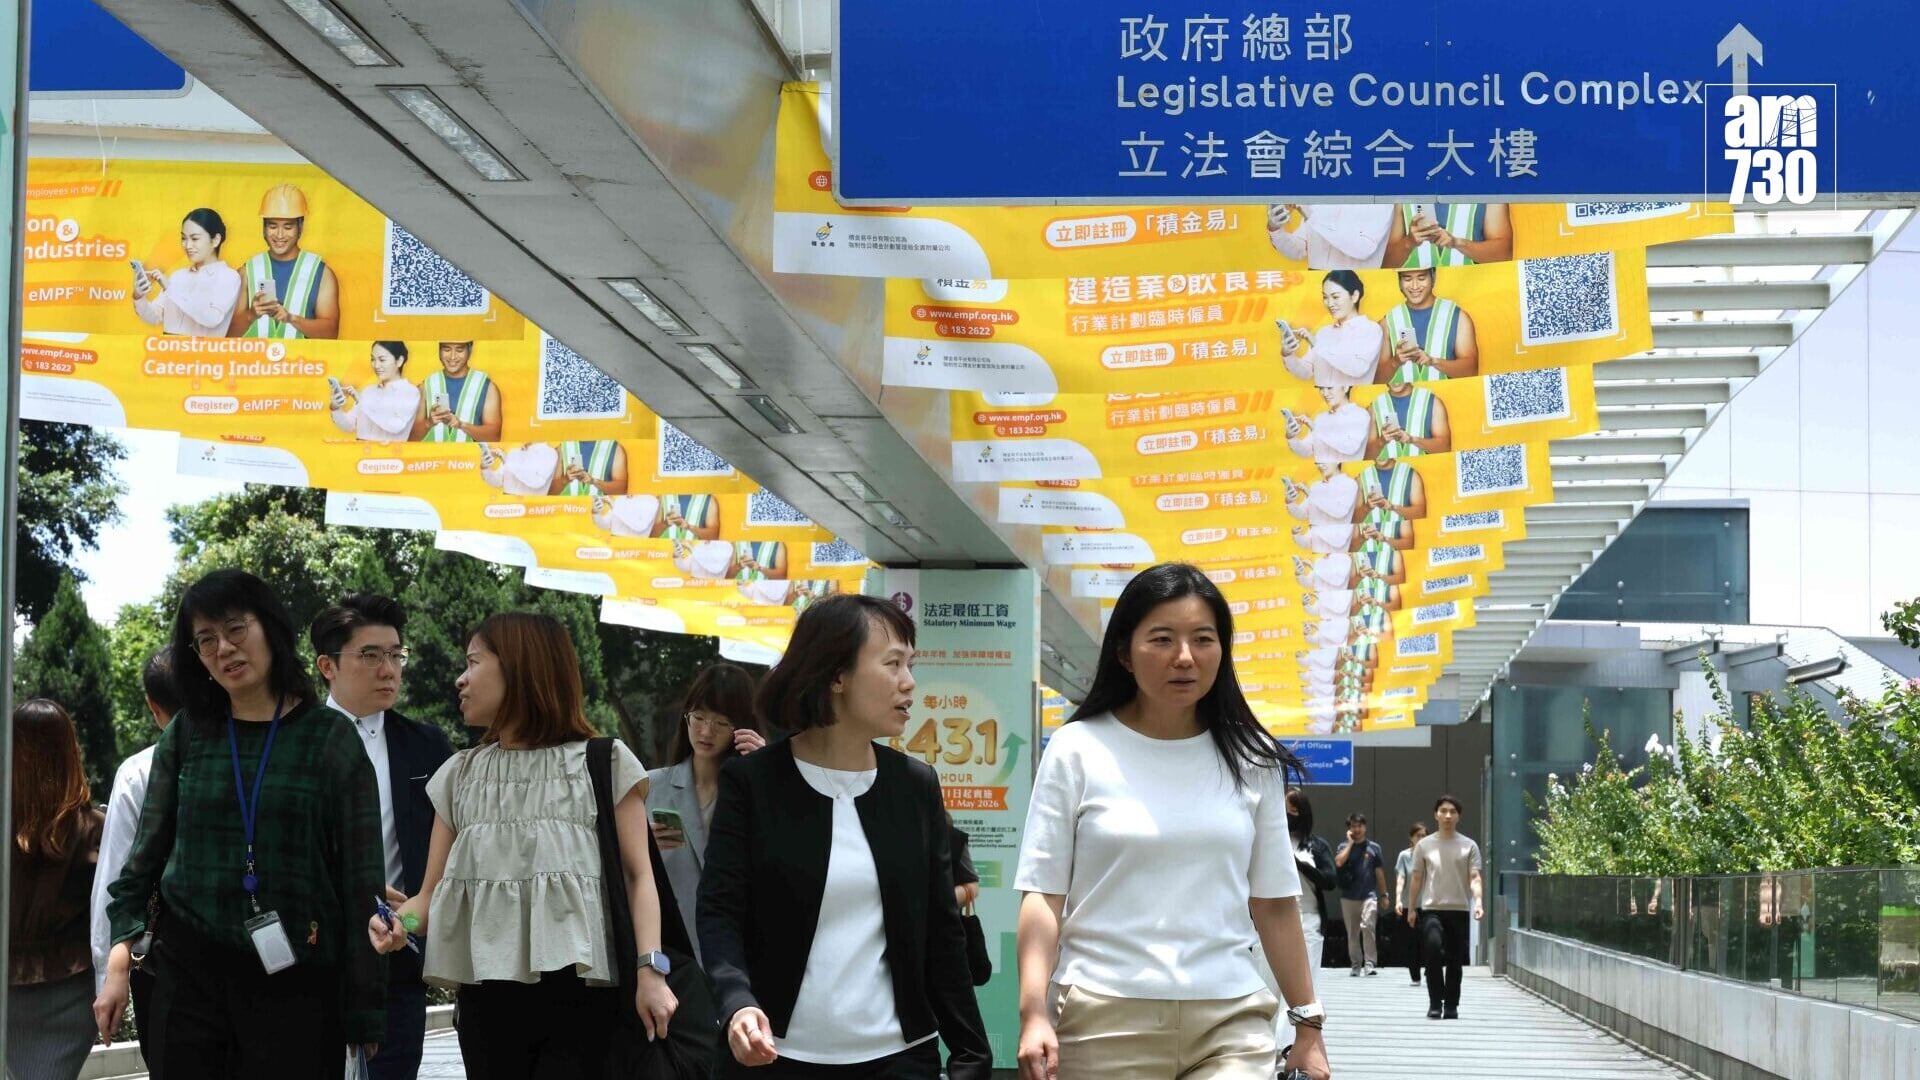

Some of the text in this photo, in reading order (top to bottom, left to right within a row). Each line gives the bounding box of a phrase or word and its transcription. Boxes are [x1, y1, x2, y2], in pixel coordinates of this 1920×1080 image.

[1119, 12, 1353, 62] 政府總部
[1116, 71, 1704, 116] Legislative Council Complex
[1118, 127, 1539, 179] 立法會綜合大樓
[70, 186, 79, 194] in
[81, 184, 96, 194] the
[1055, 221, 1128, 242] 立即註冊
[89, 286, 126, 301] Now
[930, 310, 1014, 323] www.empf.org.hk
[1071, 304, 1224, 333] 行業計劃臨時僱員
[951, 326, 991, 336] 183 2622
[146, 336, 266, 353] Construction
[1110, 347, 1168, 364] 立即註冊
[35, 361, 72, 372] 183 2622
[144, 359, 325, 380] Catering Industries
[190, 400, 234, 412] Register
[292, 399, 324, 410] Now
[989, 412, 1062, 424] www.empf.org.hk
[1024, 426, 1044, 434] 2622
[1143, 435, 1192, 451] 立即註冊
[362, 462, 400, 473] Register
[448, 460, 474, 470] Now
[564, 503, 588, 514] Now
[924, 603, 1009, 618] 法定最低工資
[923, 619, 1017, 629] Statutory Minimum Wage
[923, 694, 968, 710] 每小時
[940, 773, 973, 783] HOUR
[957, 799, 975, 809] May
[977, 799, 999, 808] 2026
